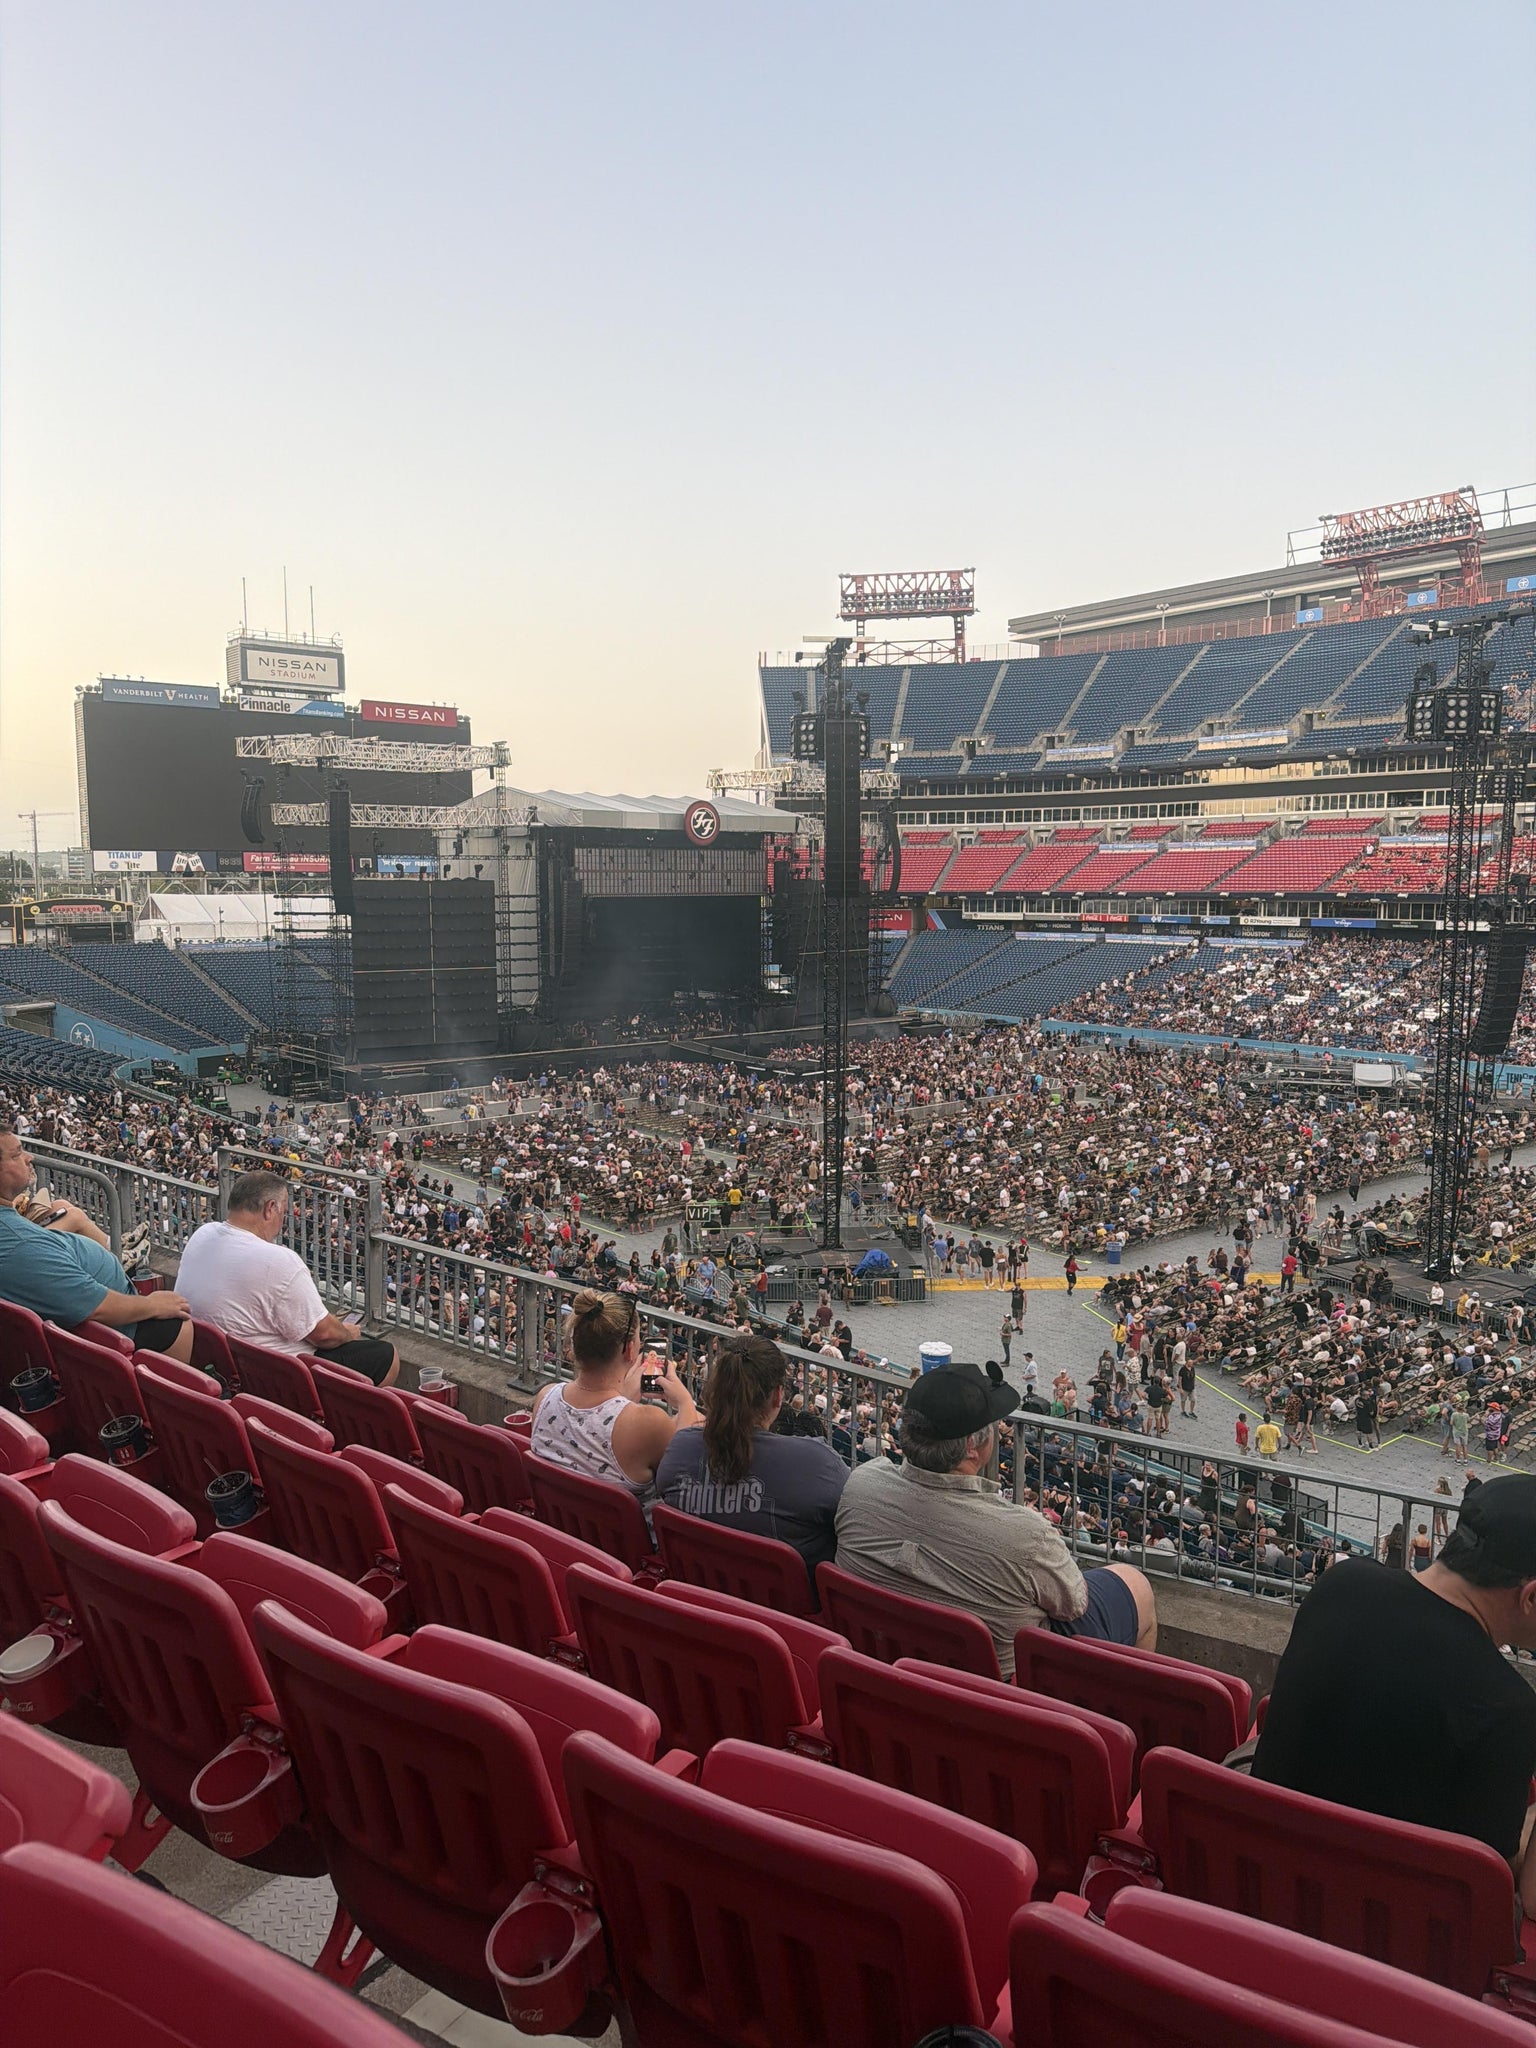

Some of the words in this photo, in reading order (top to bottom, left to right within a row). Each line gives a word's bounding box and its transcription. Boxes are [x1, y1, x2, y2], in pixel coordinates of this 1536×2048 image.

[258, 656, 327, 672] NISSAN
[270, 669, 317, 680] STADIUM
[113, 687, 163, 698] VANDERBILT
[178, 692, 209, 701] HEALTH
[241, 696, 291, 713] Pinnacle
[375, 706, 445, 722] NISSAN
[107, 851, 131, 860] TITAN
[131, 852, 143, 860] UP
[250, 854, 271, 863] Farm
[125, 861, 141, 870] Lite
[688, 1207, 709, 1219] VIP
